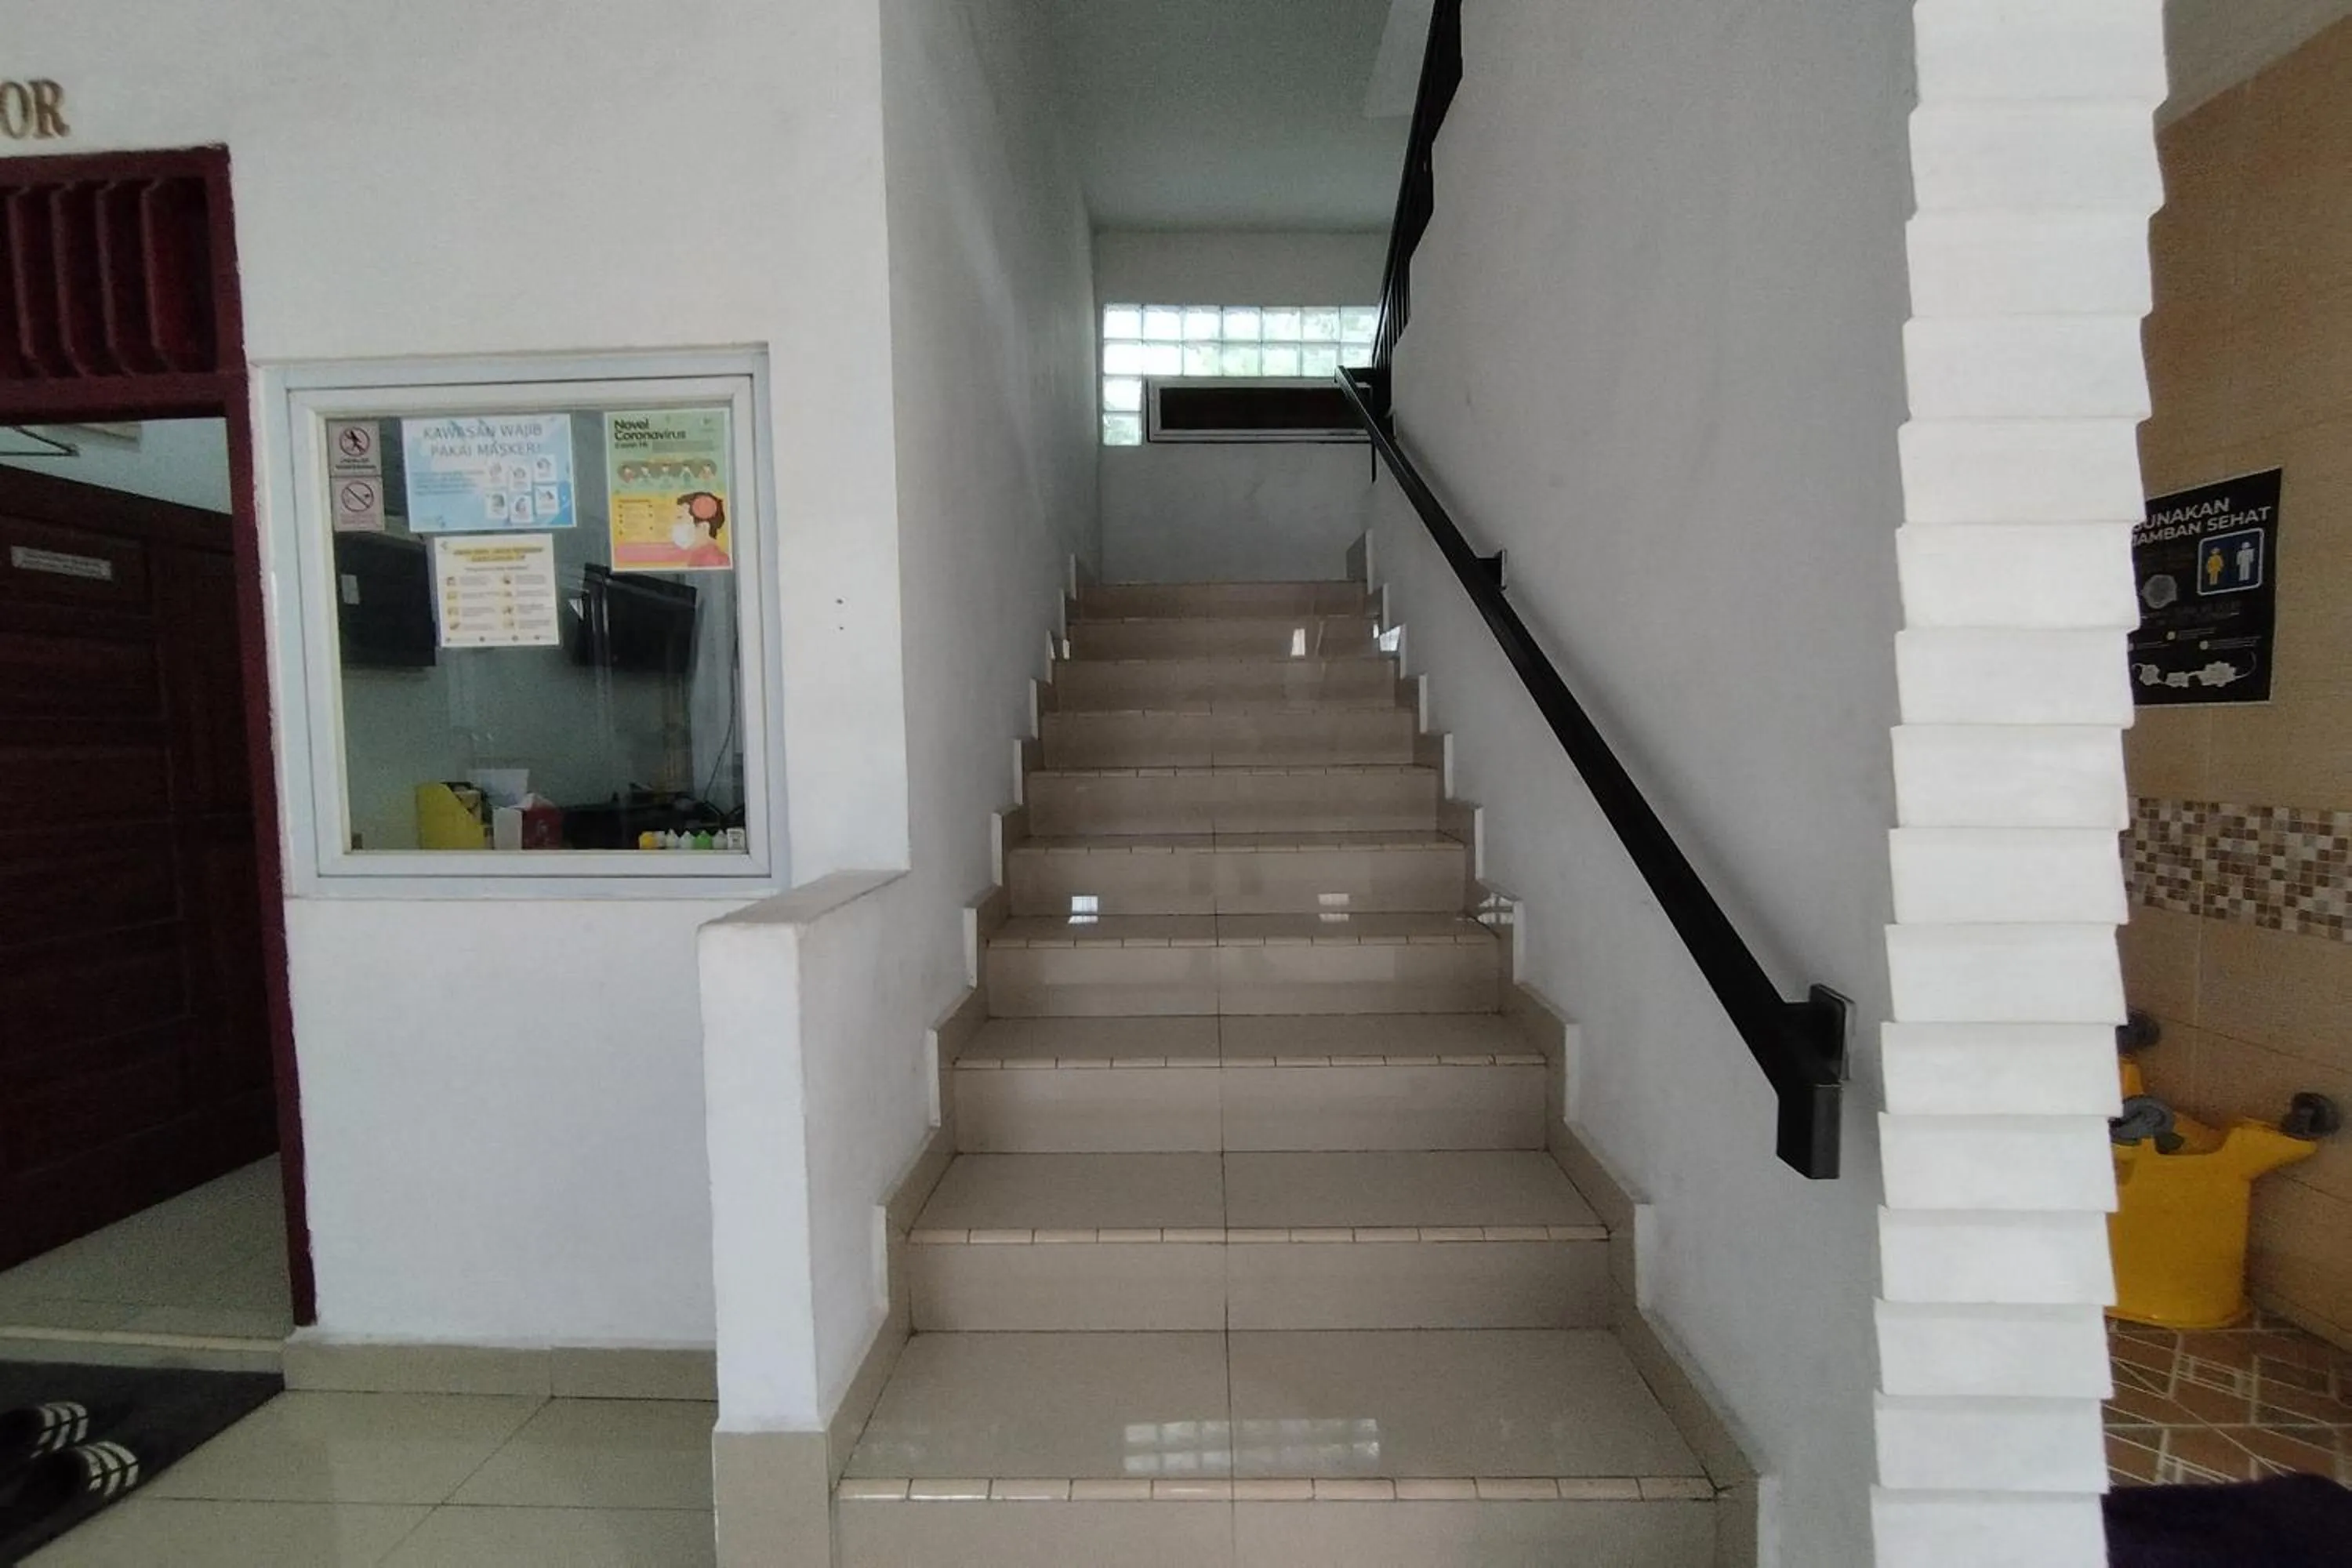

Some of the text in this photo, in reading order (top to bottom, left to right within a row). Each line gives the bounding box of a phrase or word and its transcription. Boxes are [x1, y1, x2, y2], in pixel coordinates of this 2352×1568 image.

[423, 423, 543, 439] KAWASAN WAJIB
[614, 419, 649, 430] Novel
[614, 429, 686, 441] Coronavirus
[432, 444, 471, 457] PAKAI
[2207, 506, 2271, 532] SEHAT
